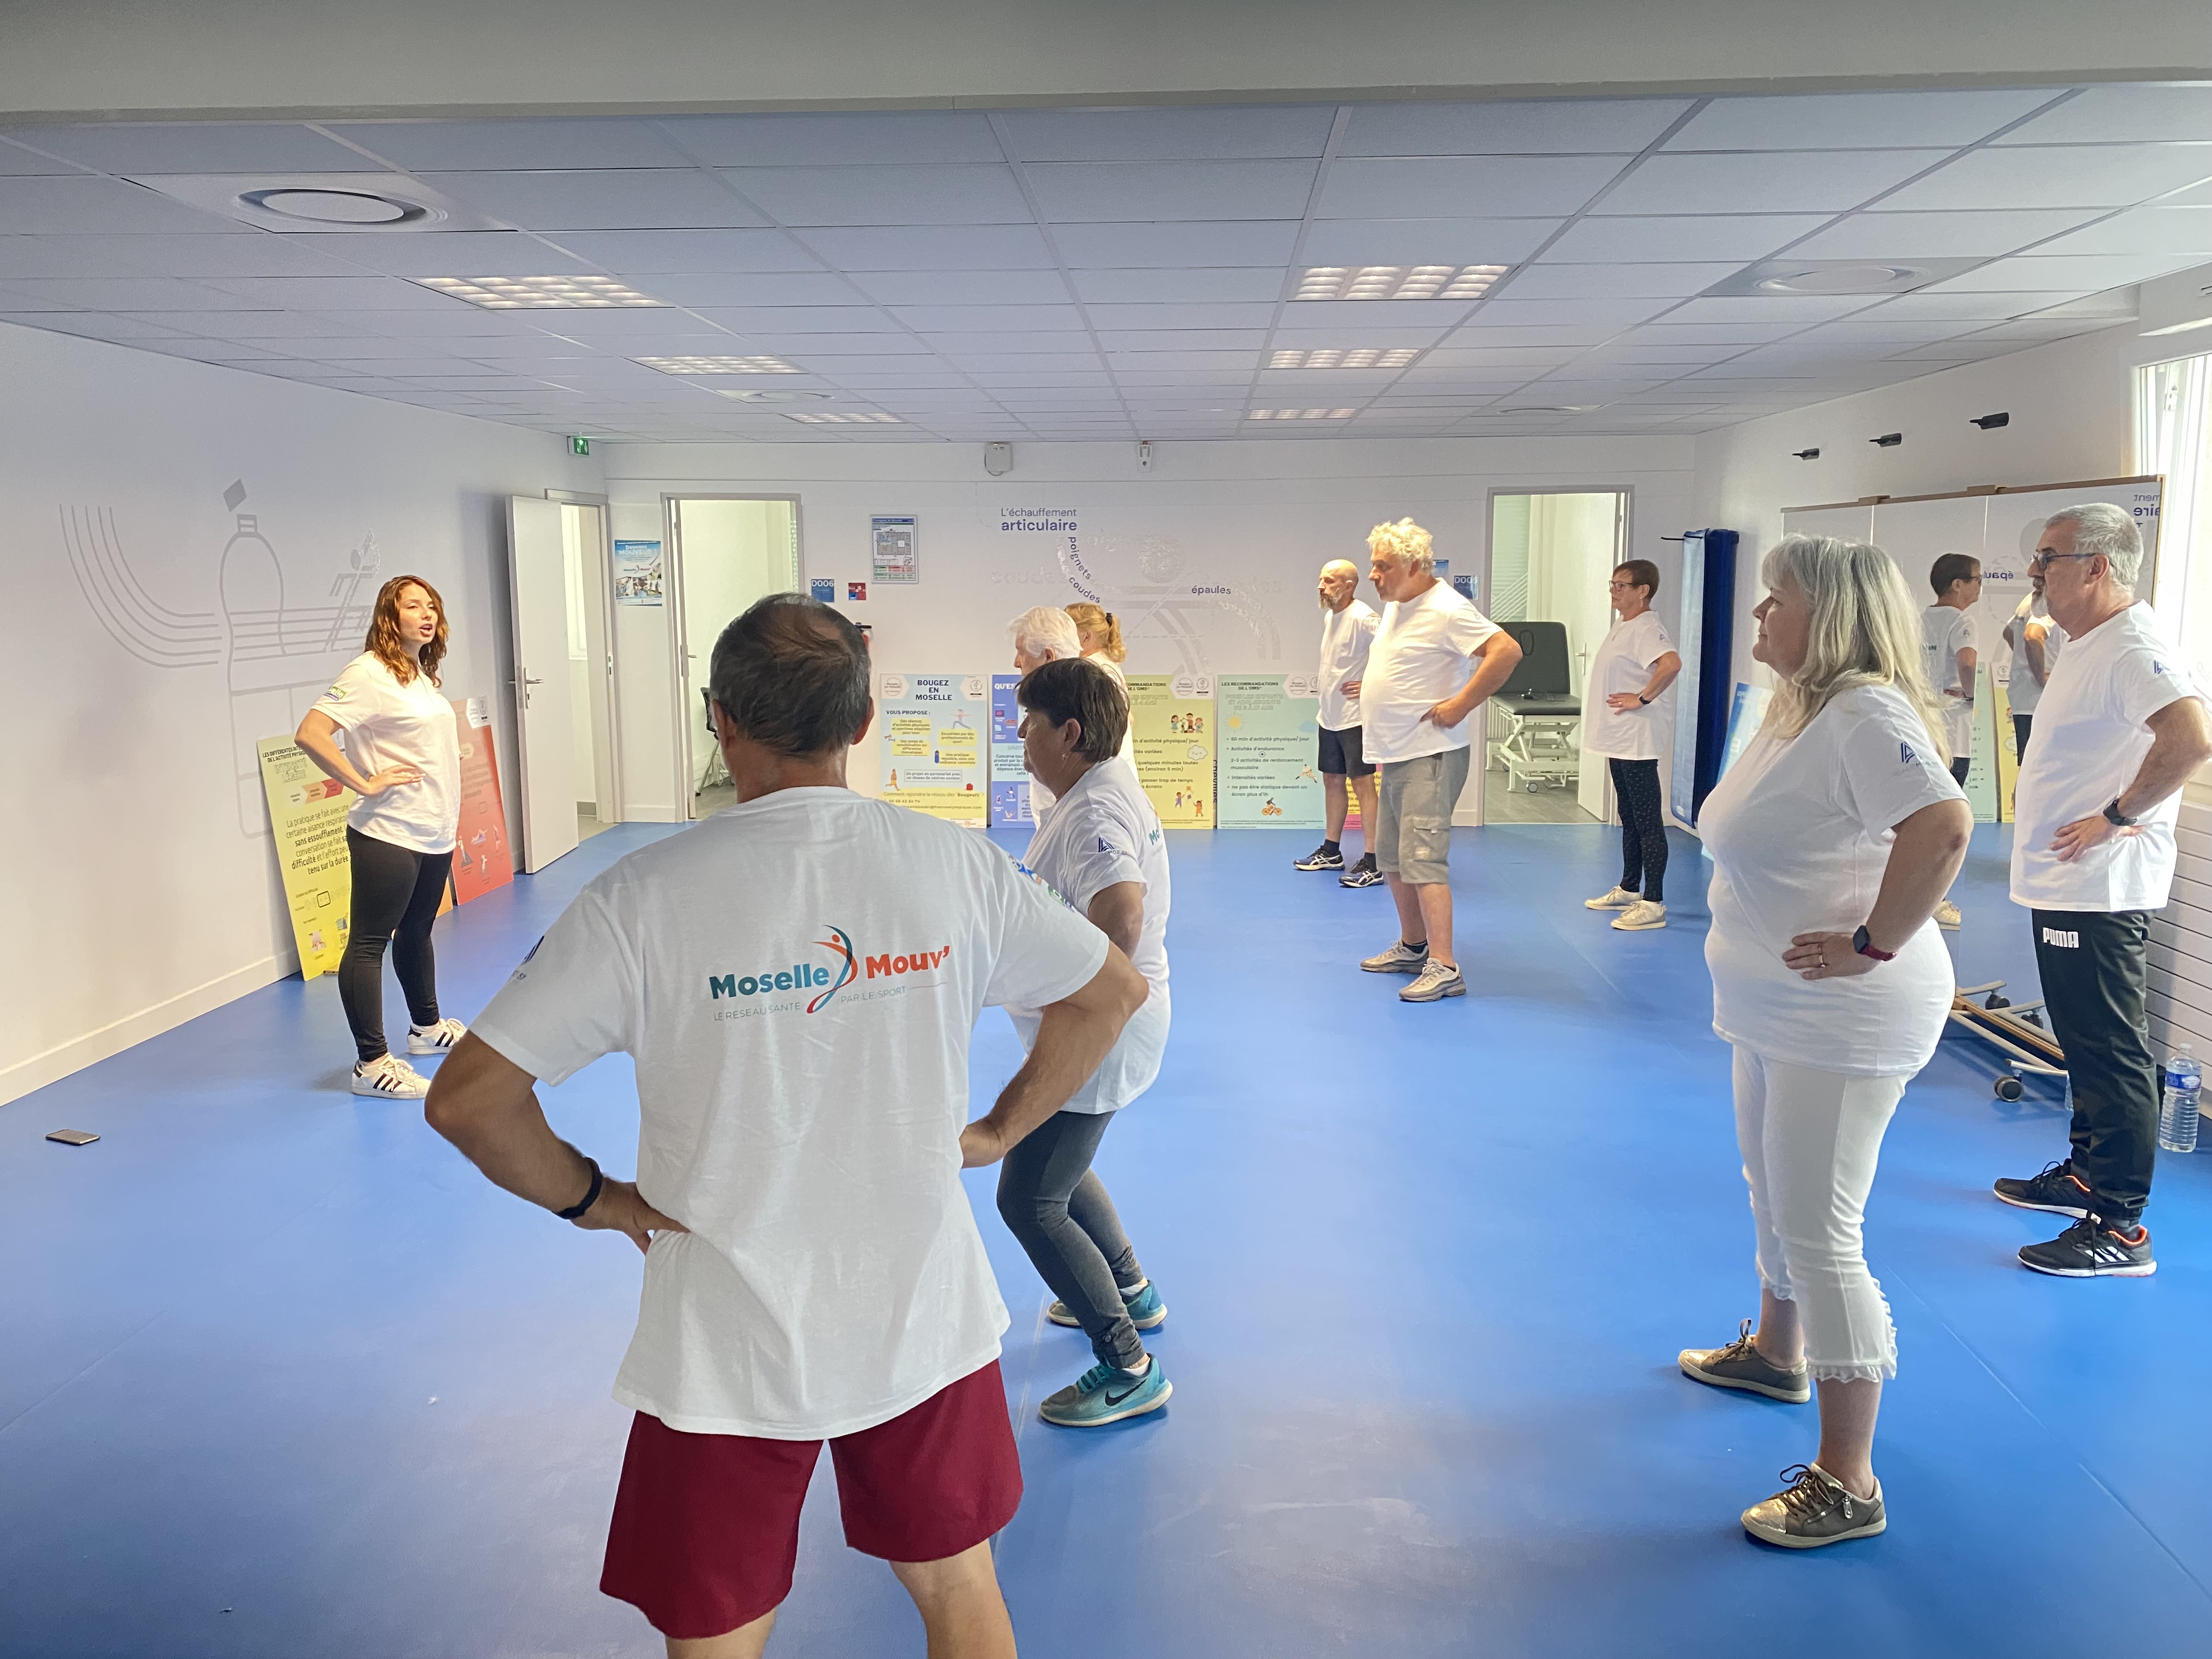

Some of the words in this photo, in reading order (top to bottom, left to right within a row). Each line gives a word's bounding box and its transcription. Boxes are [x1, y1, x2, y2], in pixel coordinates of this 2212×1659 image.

[1001, 507, 1077, 517] L'échauffement
[1001, 518, 1077, 531] articulaire
[1068, 537, 1091, 580] poignets
[1069, 577, 1101, 603] coudes
[1192, 585, 1232, 596] épaules
[269, 747, 292, 756] DIFFÉRENTES
[286, 820, 294, 828] La
[294, 814, 314, 827] pratique
[321, 809, 330, 818] fait
[330, 807, 340, 815] avec
[286, 827, 307, 839] certaine
[308, 822, 325, 833] aisance
[295, 838, 307, 847] sans
[296, 842, 328, 857] conversation
[333, 837, 342, 845] fait
[291, 854, 316, 870] difficulté
[323, 847, 339, 860] l'effort
[307, 866, 320, 875] tenu
[320, 862, 329, 871] sur
[329, 859, 334, 867] la
[2042, 927, 2079, 949] PUMA
[709, 963, 830, 1000] Moselle
[865, 945, 950, 979] Mouv'
[714, 1012, 723, 1021] LE
[725, 1005, 766, 1020] RÉSEAU
[840, 994, 859, 1004] PAR
[862, 992, 874, 1001] LE
[877, 985, 906, 998] SPORT
